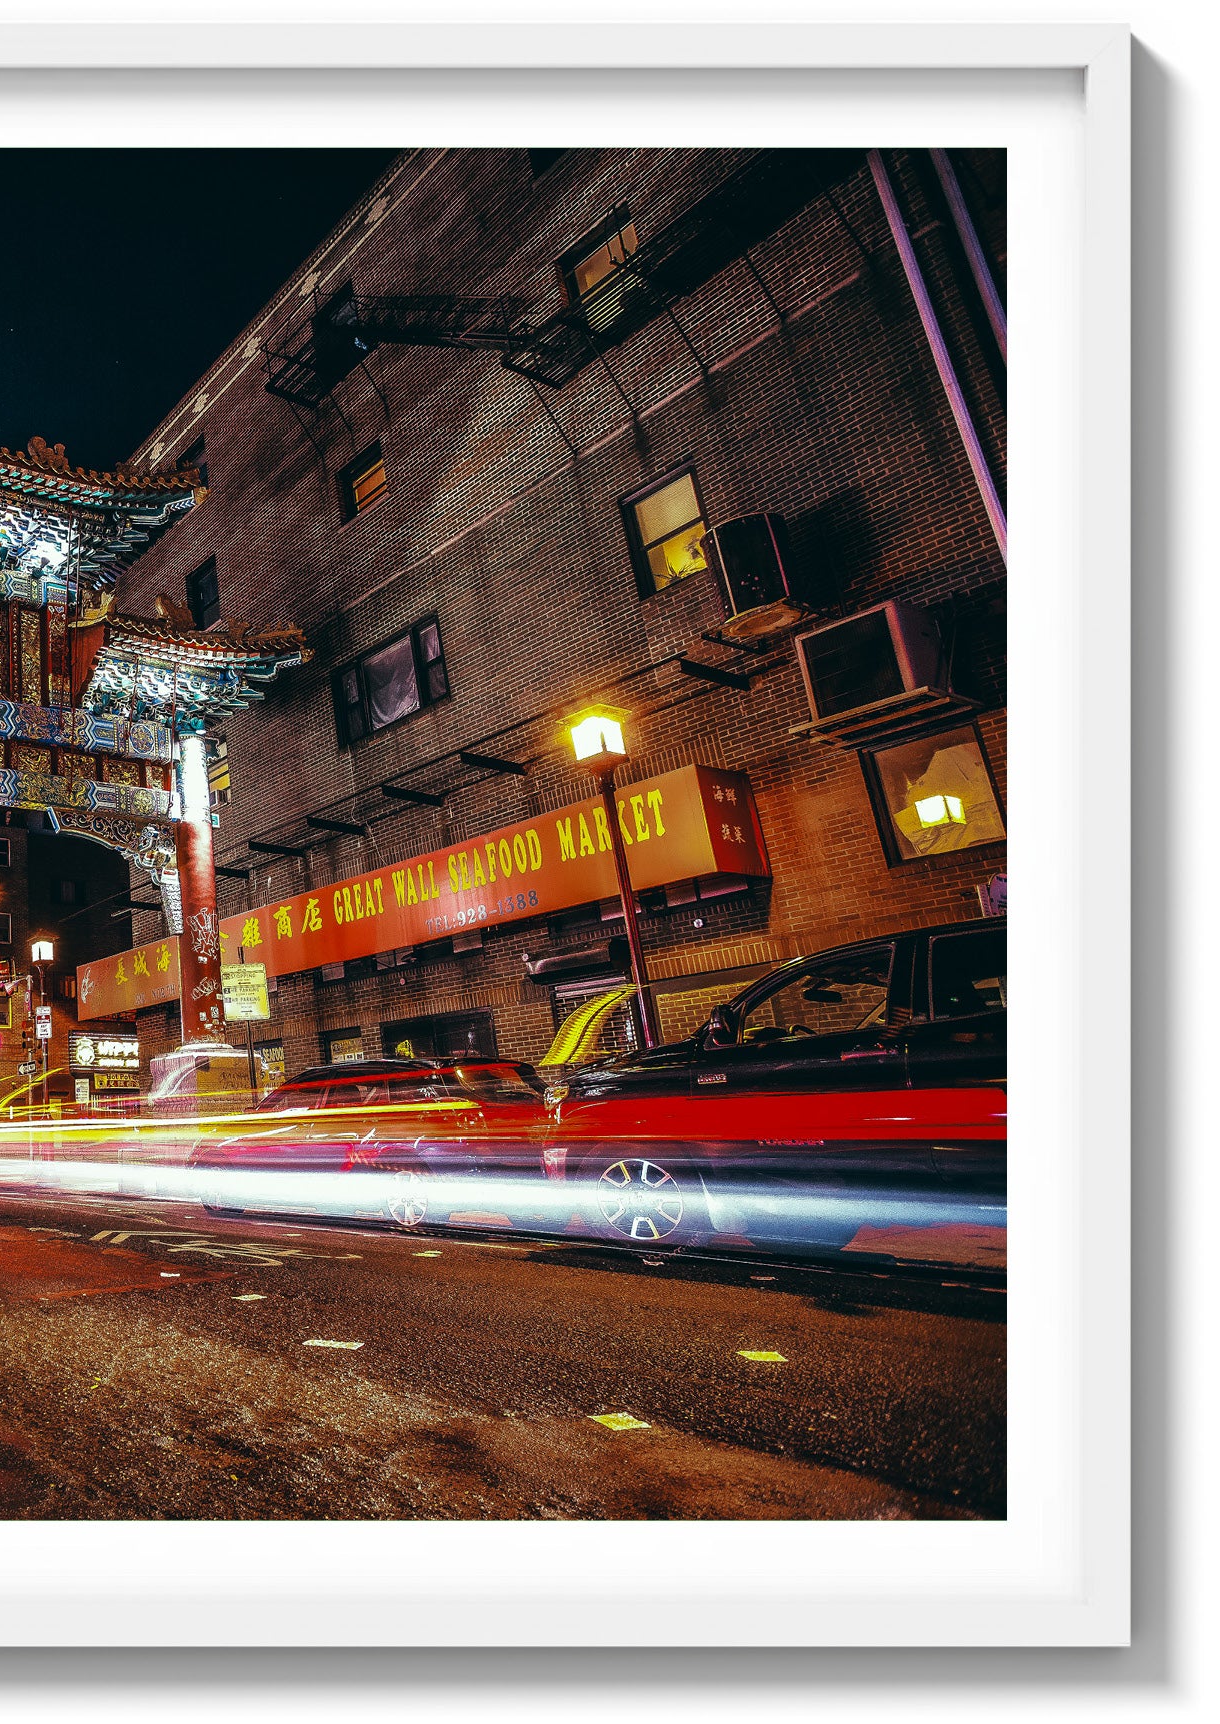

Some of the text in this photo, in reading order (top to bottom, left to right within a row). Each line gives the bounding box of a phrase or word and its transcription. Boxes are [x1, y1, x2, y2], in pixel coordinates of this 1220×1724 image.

[333, 877, 385, 925] GREAT
[391, 860, 440, 908] WALL
[447, 828, 543, 894] SEAFOOD
[555, 788, 667, 862] MARKET
